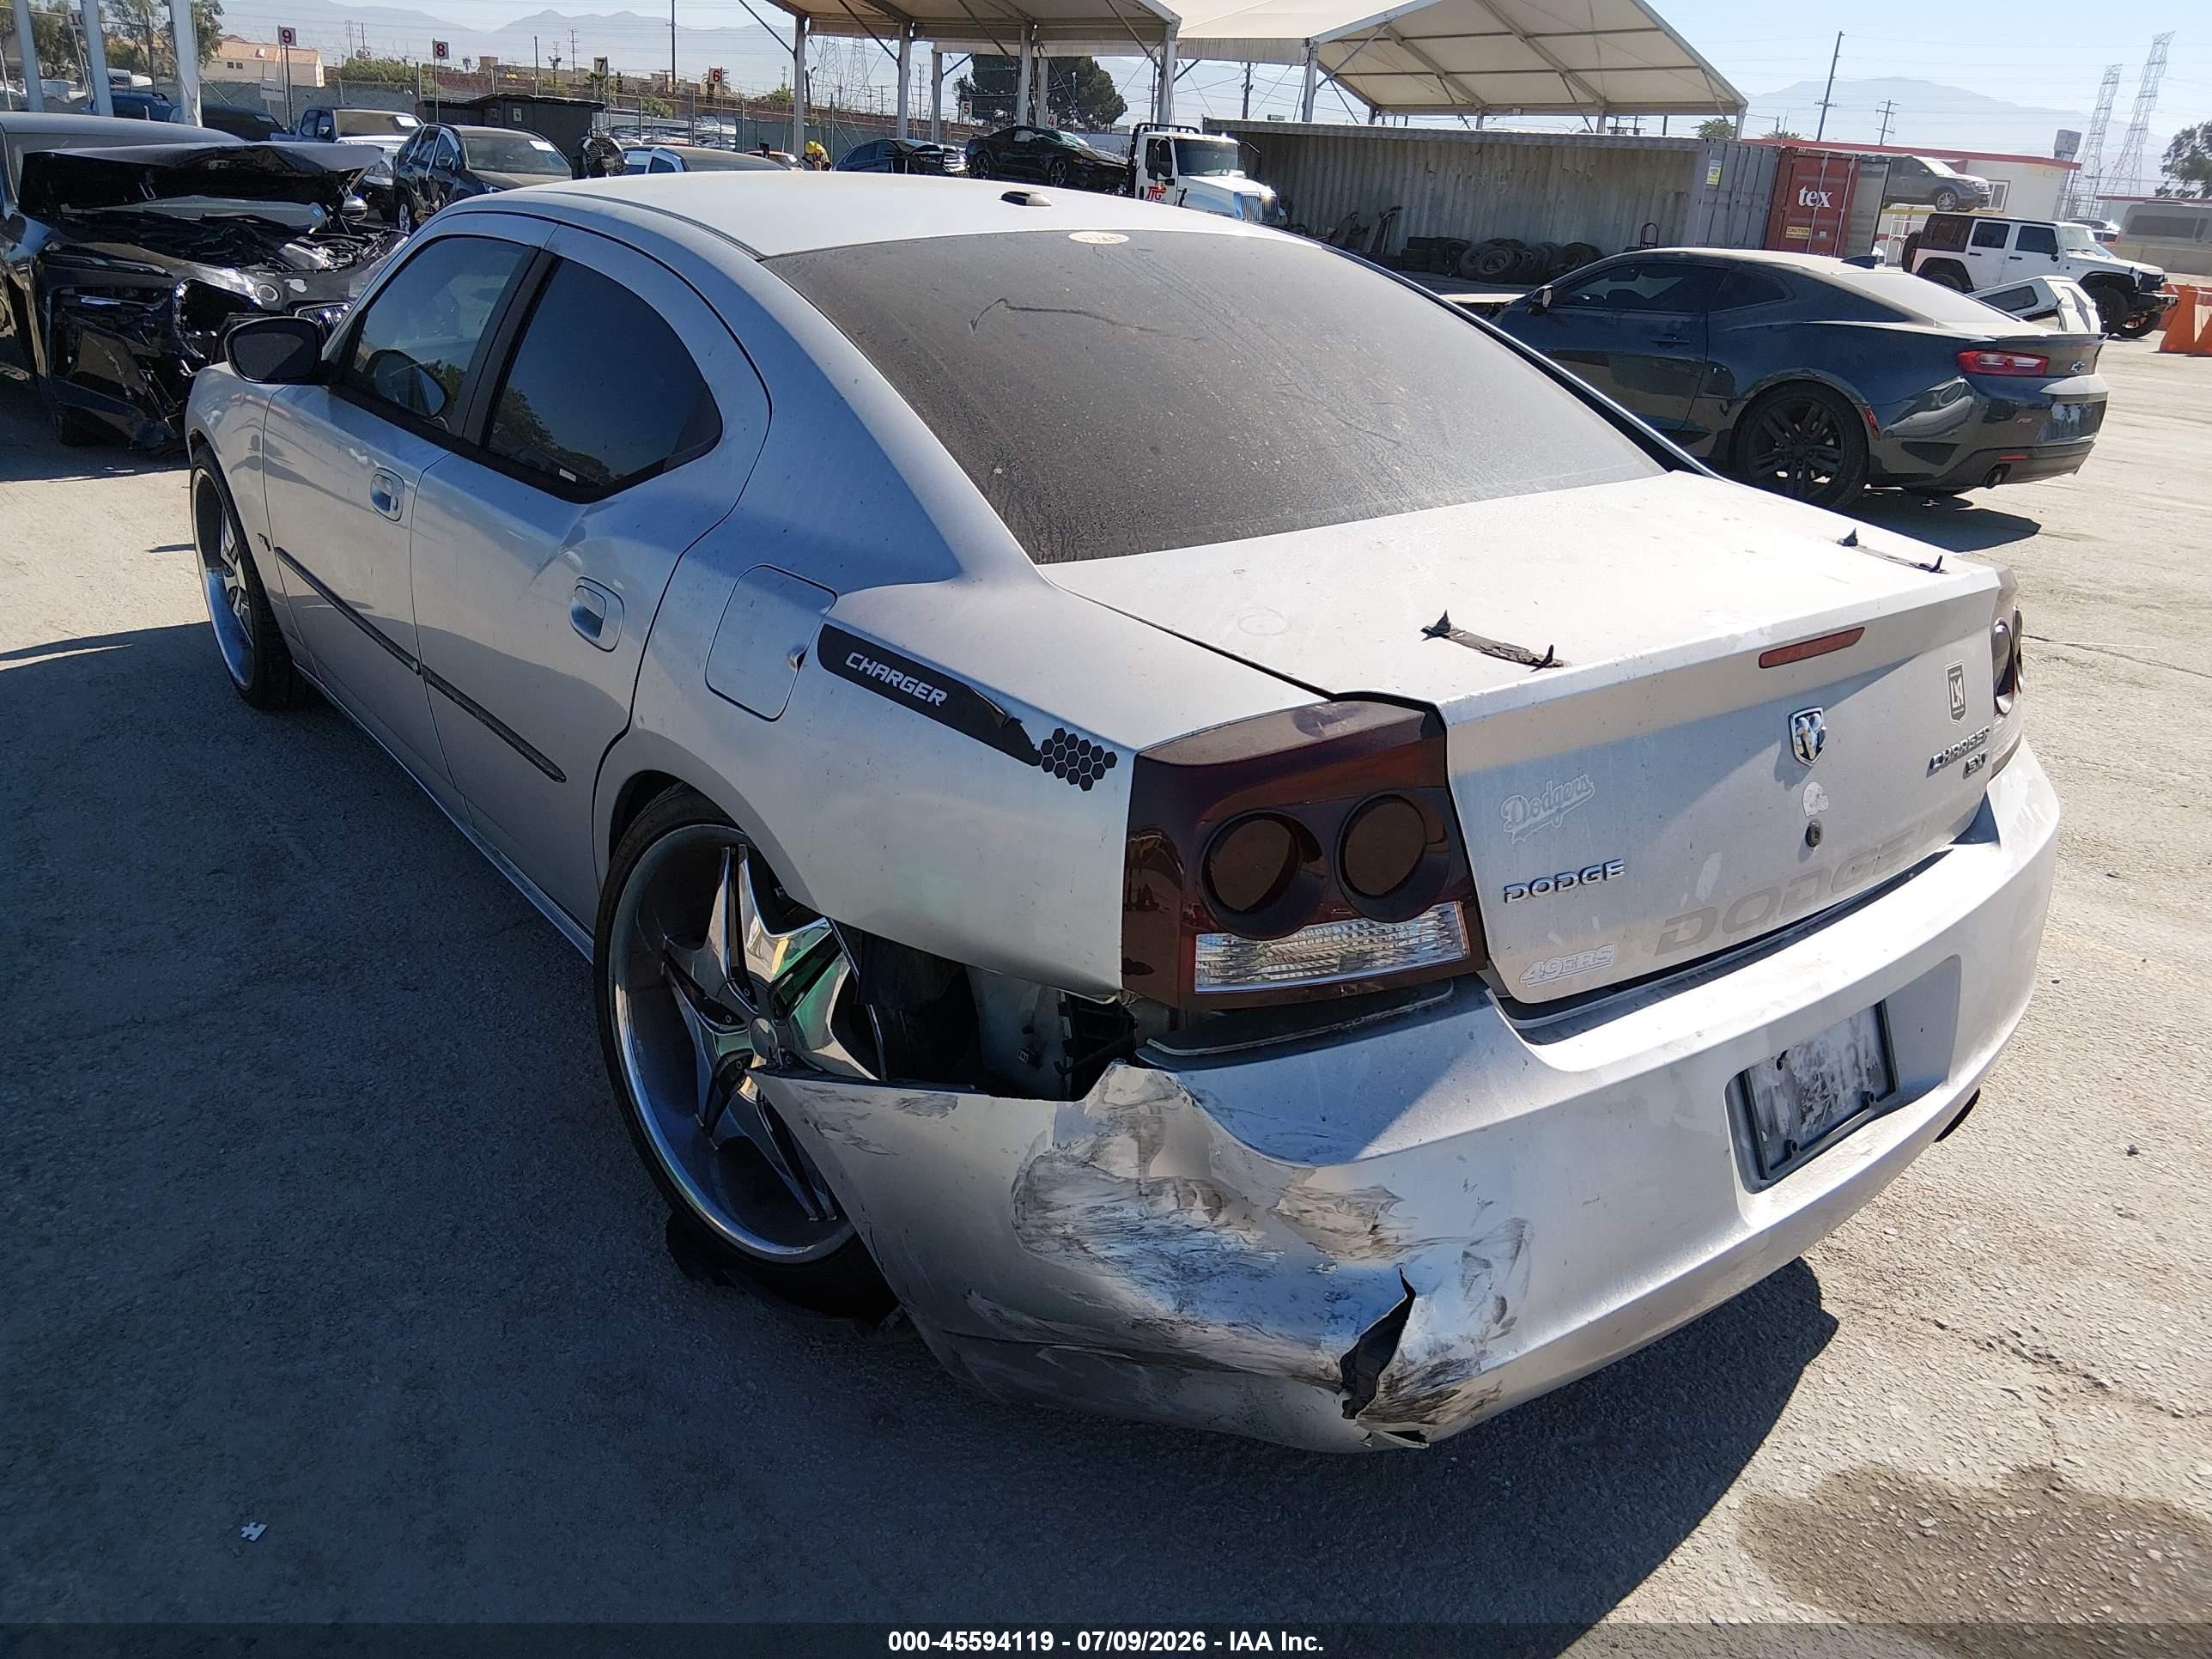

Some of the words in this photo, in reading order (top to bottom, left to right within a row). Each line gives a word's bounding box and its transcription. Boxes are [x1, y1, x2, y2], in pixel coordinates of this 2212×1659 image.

[282, 29, 292, 44] 9
[436, 43, 446, 57] 8
[596, 59, 605, 72] 7
[713, 70, 720, 82] 6
[963, 103, 970, 114] 5
[1048, 115, 1054, 127] 4
[1798, 185, 1833, 209] tex
[844, 651, 948, 707] CHARGER
[1501, 773, 1595, 840] Dodgers
[1504, 859, 1626, 904] DODGE
[1521, 944, 1615, 988] 49ERS
